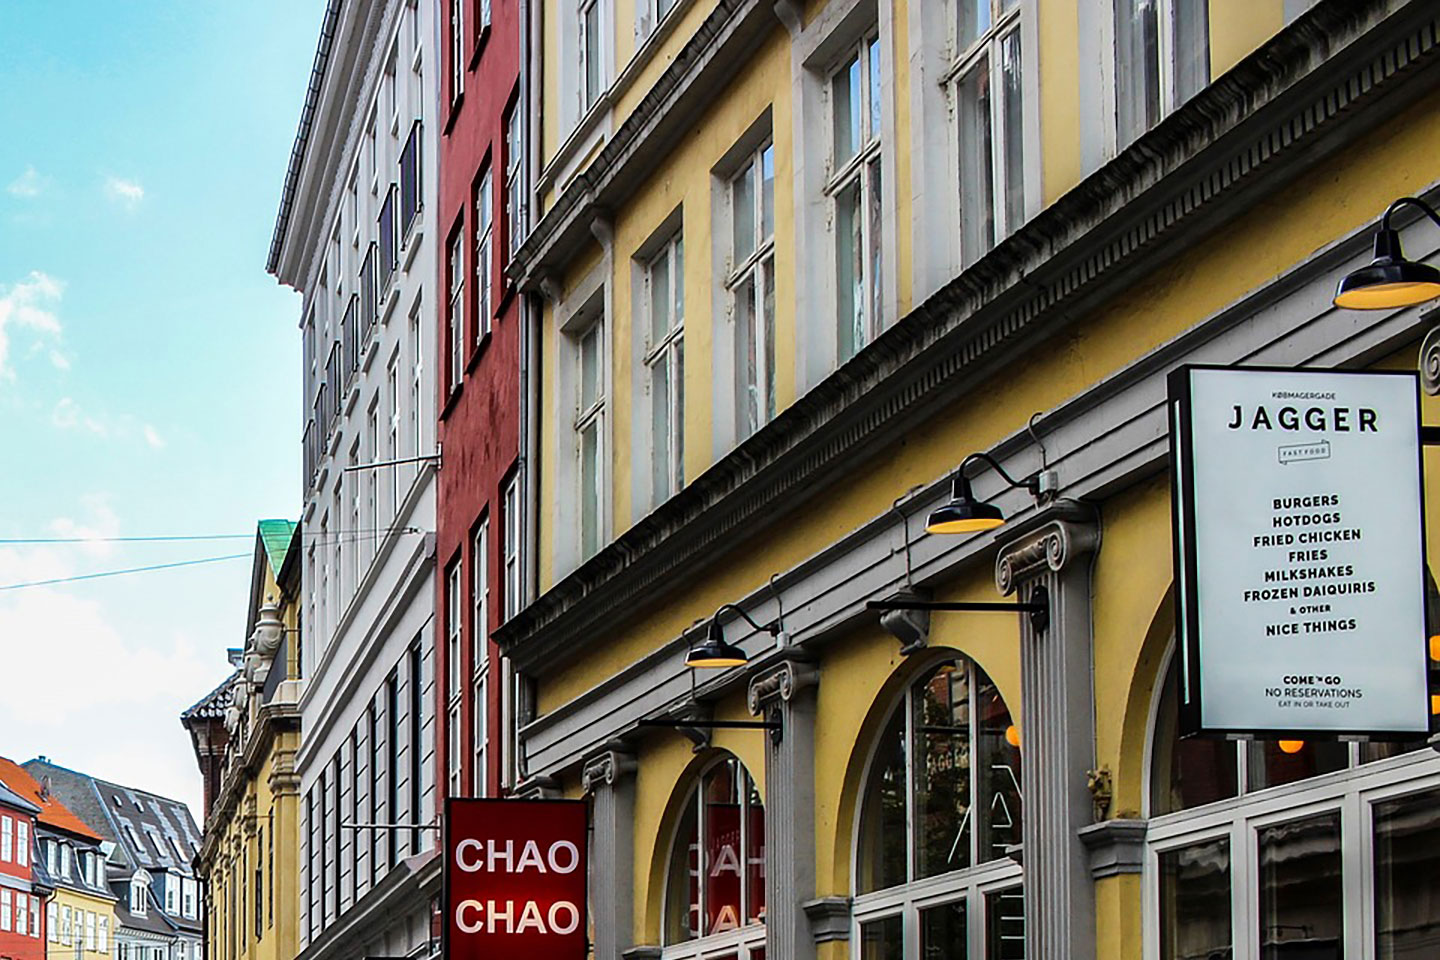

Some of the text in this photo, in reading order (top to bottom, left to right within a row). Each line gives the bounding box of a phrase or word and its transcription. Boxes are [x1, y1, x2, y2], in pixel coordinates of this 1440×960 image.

[1228, 405, 1378, 432] JAGGER
[1282, 447, 1326, 457] FAST FOOD
[1273, 495, 1339, 509] BURGERS
[1273, 512, 1341, 527] HOTDOGS
[1253, 529, 1361, 547] FRIED CHICKEN
[1288, 549, 1328, 562] FRIES
[1264, 565, 1354, 582] MILKSHAKES
[1244, 581, 1376, 602] FROZEN DAIQUIRIS
[1299, 604, 1331, 614] OTHER
[1266, 619, 1357, 636] NICE THINGS
[1283, 675, 1315, 685] COME
[1324, 675, 1341, 685] GO
[1265, 688, 1363, 698] NO RESERVATIONS
[455, 838, 580, 874] CHAO
[455, 899, 580, 935] CHAO
